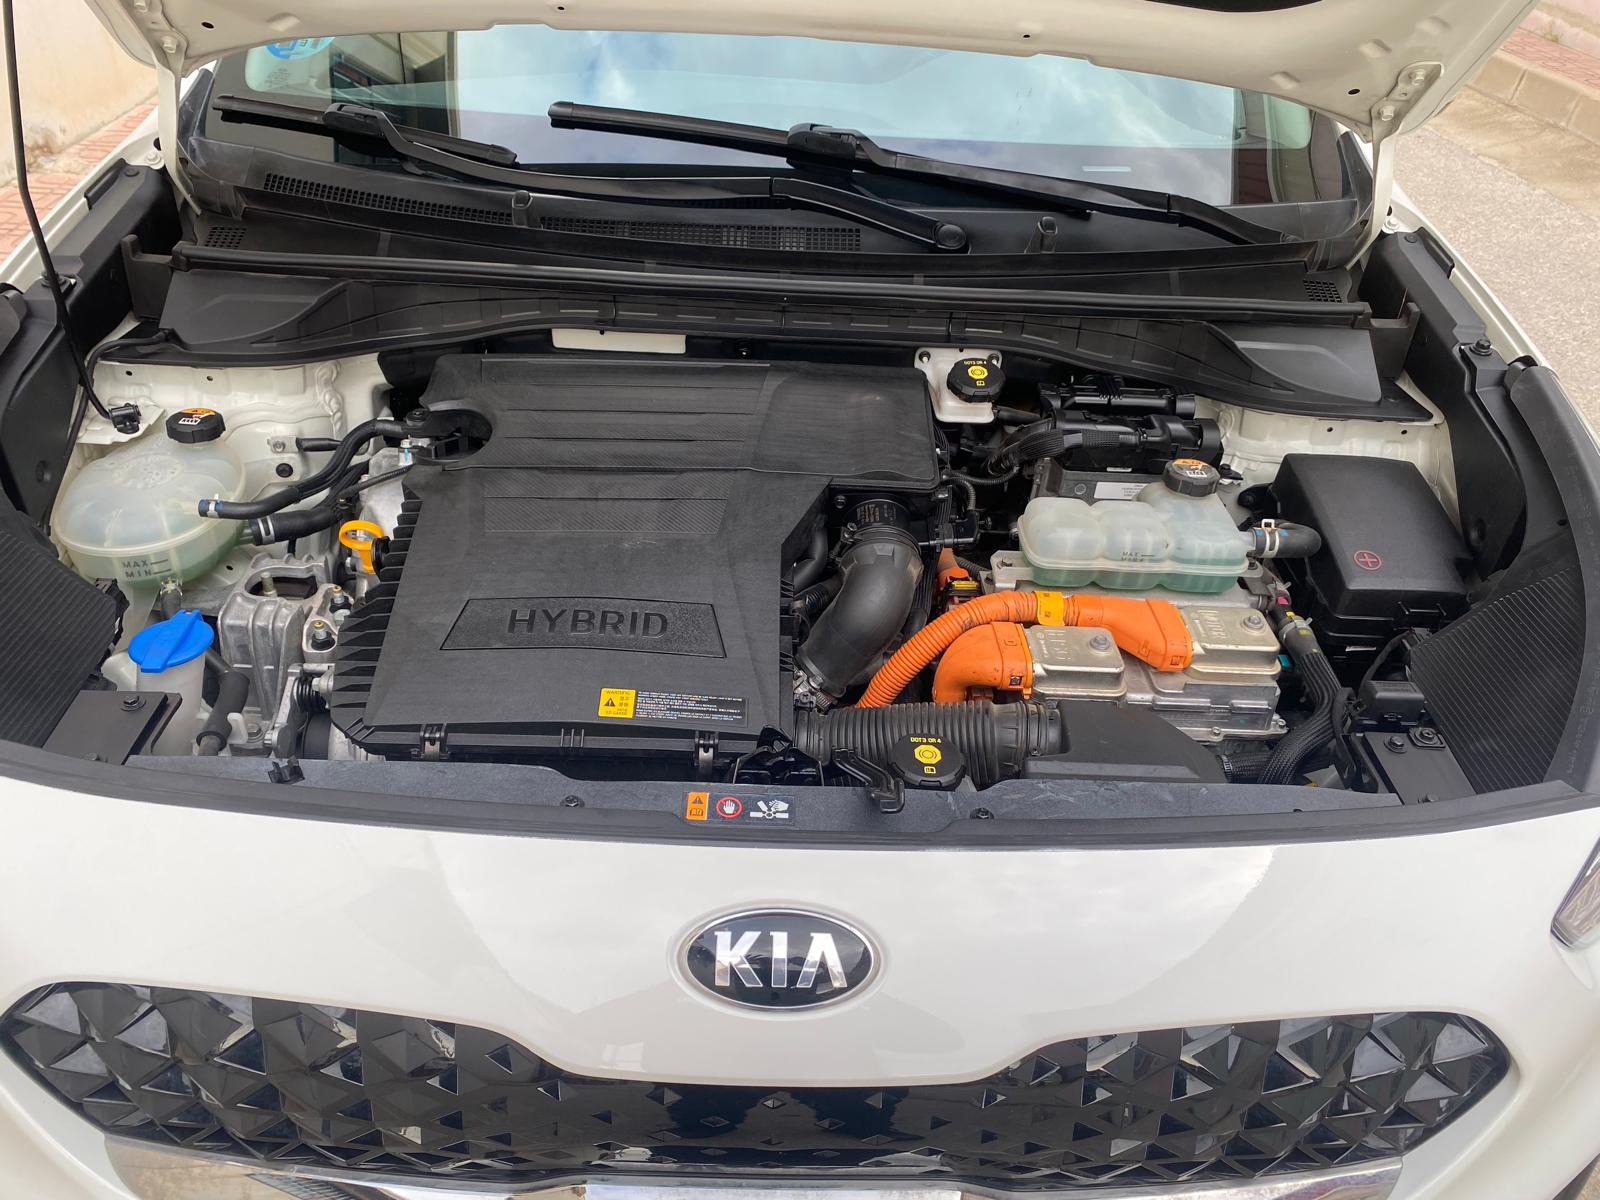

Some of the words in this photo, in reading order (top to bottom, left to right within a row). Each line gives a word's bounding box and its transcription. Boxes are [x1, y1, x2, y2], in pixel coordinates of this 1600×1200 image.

[122, 560, 148, 568] MAX
[125, 569, 152, 577] MIN
[507, 608, 668, 638] HYBRID
[714, 930, 848, 988] KIA
